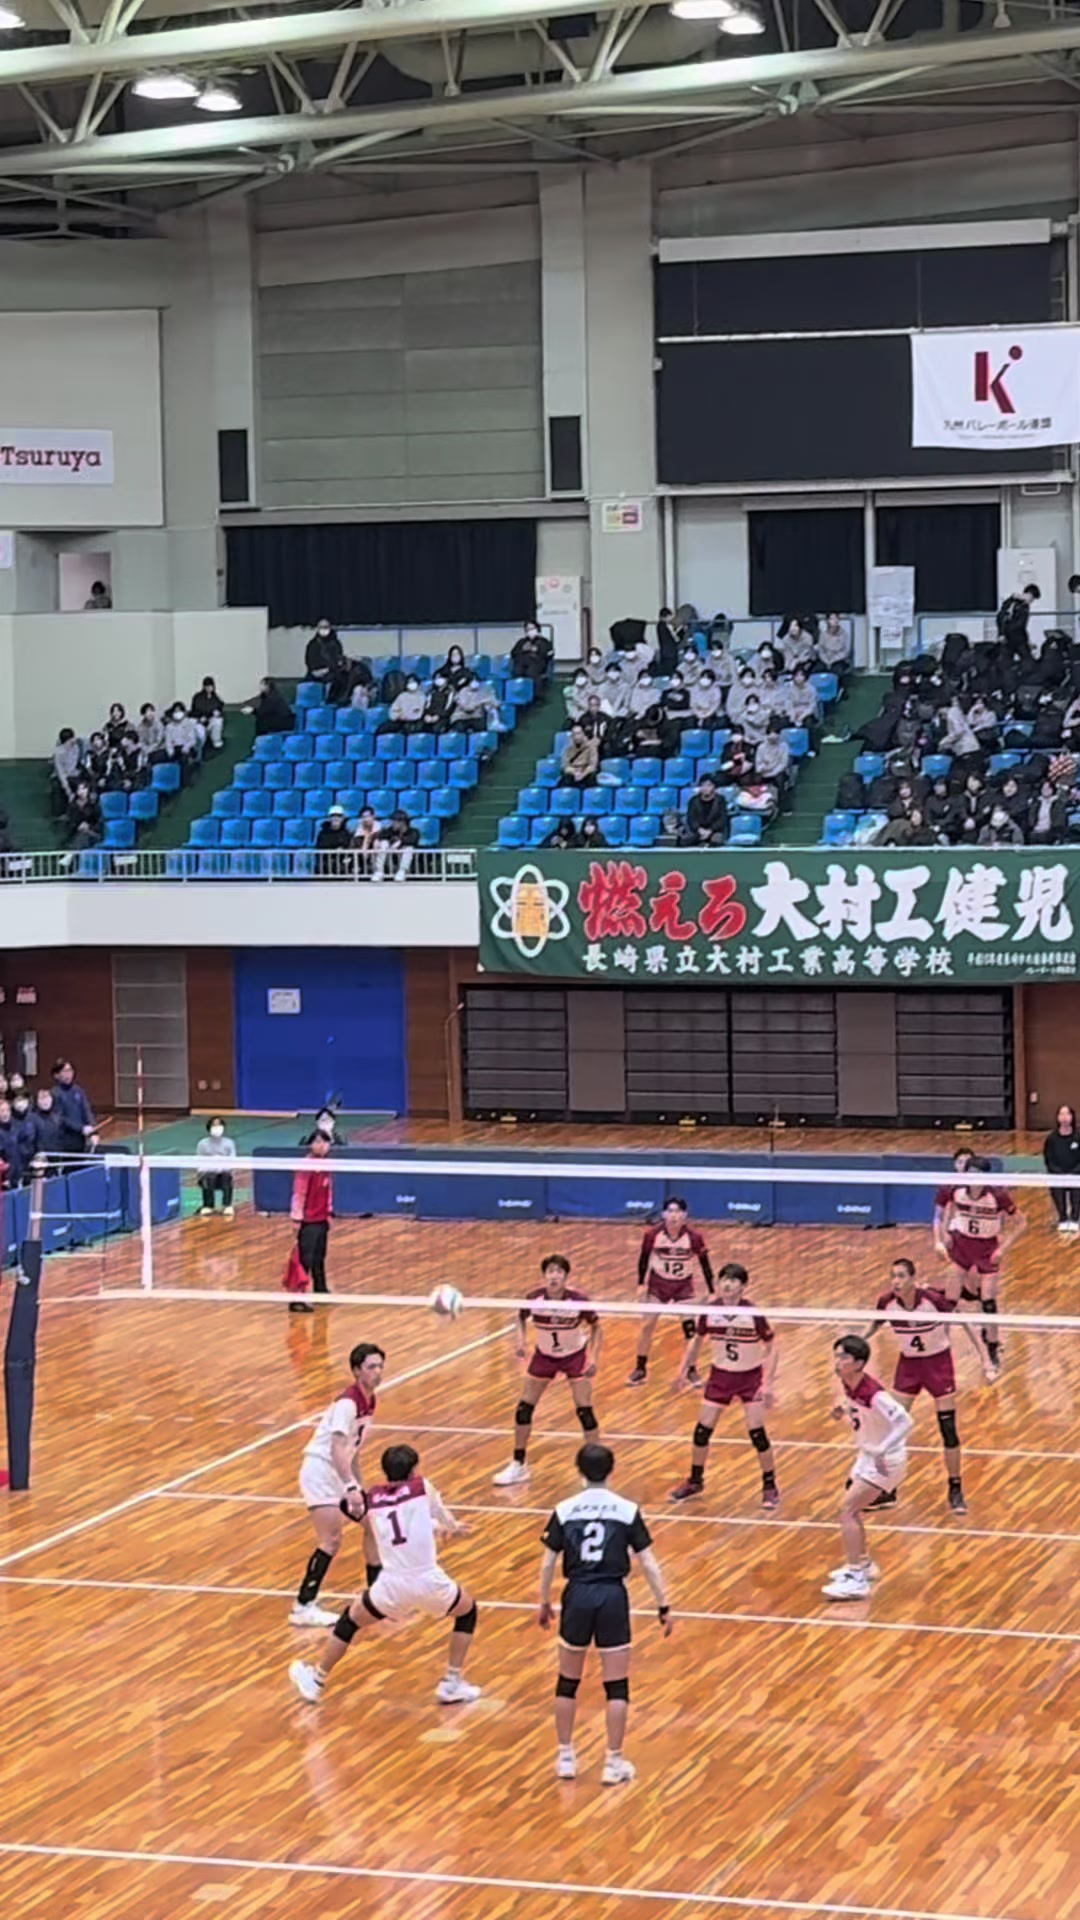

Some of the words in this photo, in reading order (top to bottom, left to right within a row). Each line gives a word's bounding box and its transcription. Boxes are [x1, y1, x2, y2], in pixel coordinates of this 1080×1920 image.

[0, 446, 101, 472] Tsuruya
[581, 943, 954, 978] 長崎県立大村工業高等学校
[968, 1219, 980, 1235] 6
[664, 1261, 685, 1278] 12
[551, 1331, 561, 1348] 1
[909, 1335, 925, 1352] 4
[725, 1343, 739, 1362] 5
[387, 1510, 406, 1546] 1
[580, 1521, 605, 1562] 2
